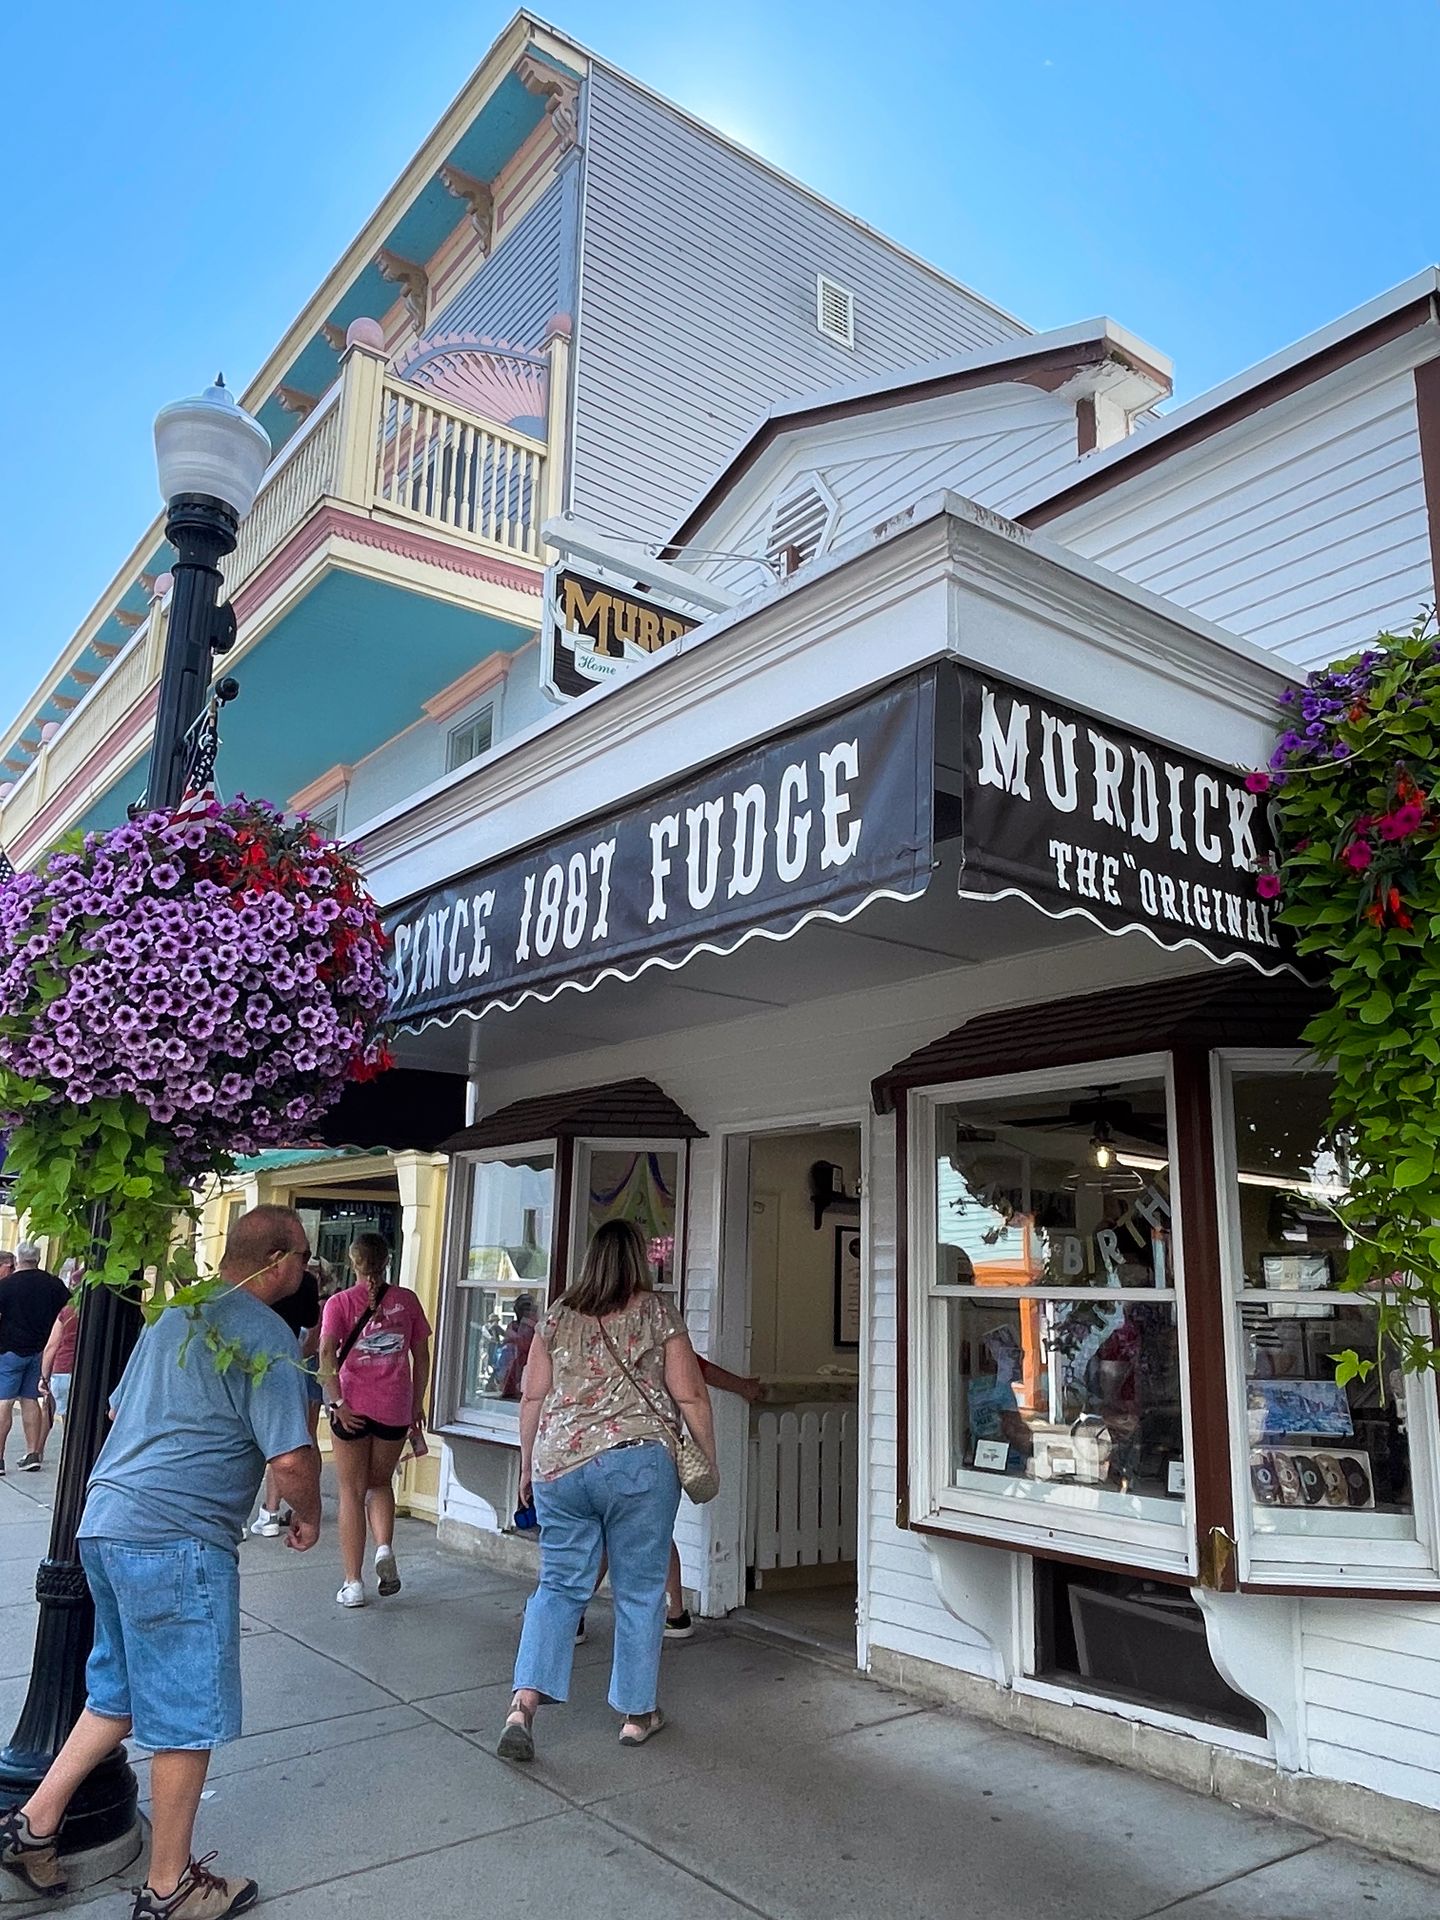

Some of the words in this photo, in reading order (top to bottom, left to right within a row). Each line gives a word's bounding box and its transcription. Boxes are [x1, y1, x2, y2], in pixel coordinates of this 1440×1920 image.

[564, 578, 693, 656] MURD
[578, 655, 617, 676] Home
[387, 889, 496, 1002] SINCE
[515, 837, 617, 964] 1887
[647, 737, 862, 924] FUDGE
[1049, 839, 1122, 906] THE
[1063, 1165, 1171, 1276] BIRTH
